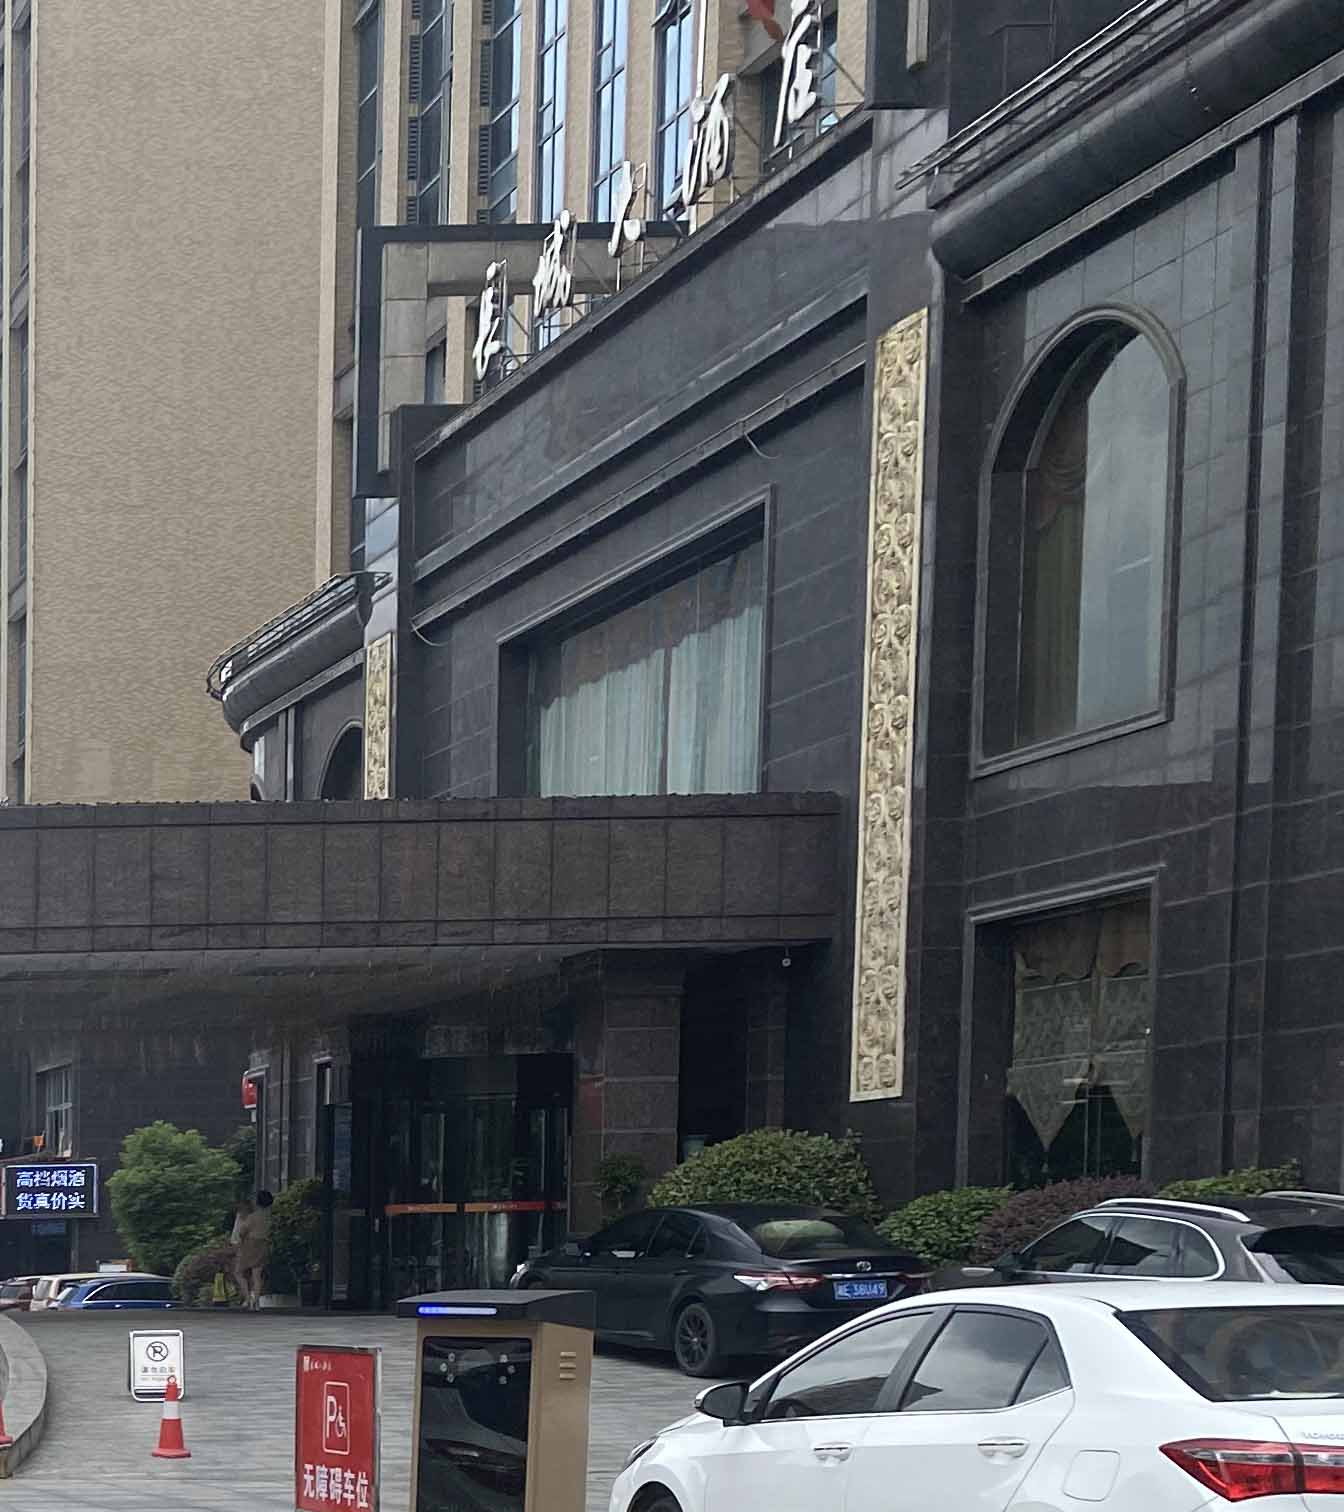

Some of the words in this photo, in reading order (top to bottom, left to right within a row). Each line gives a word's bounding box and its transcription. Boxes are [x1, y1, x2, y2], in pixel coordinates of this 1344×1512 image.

[16, 1169, 86, 1188] 高档烟酒
[15, 1192, 86, 1211] 货真价实
[303, 1463, 369, 1509] 无障碍车位
